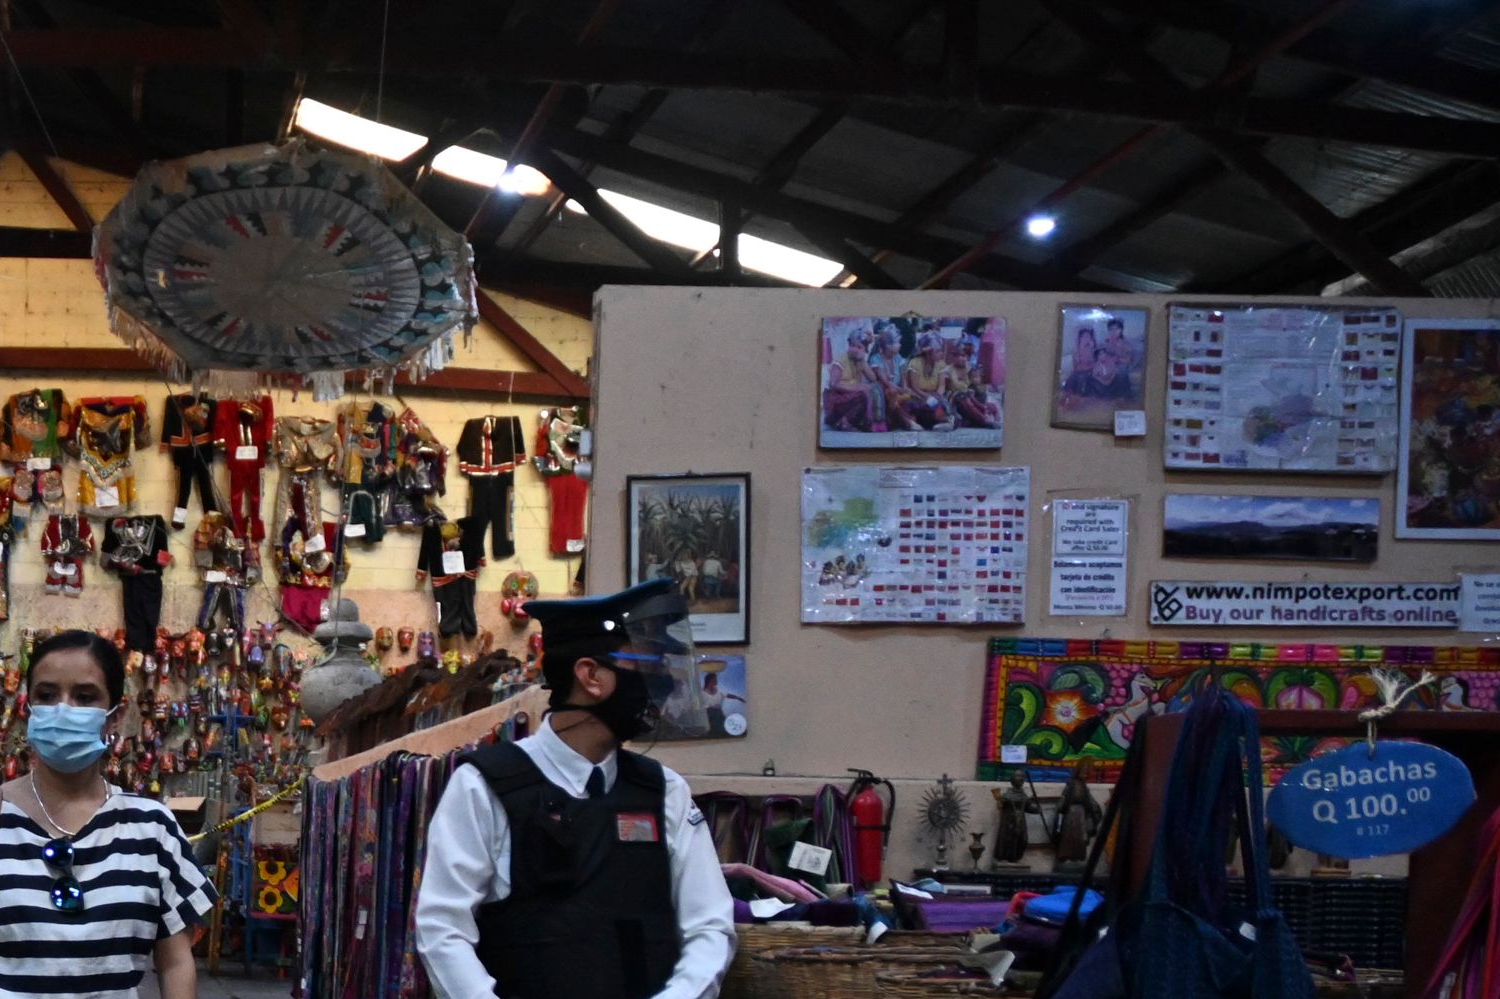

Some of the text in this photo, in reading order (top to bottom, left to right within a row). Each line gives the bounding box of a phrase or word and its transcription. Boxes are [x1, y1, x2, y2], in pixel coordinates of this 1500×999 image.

[1186, 584, 1460, 602] www.nimpotexport.com
[1186, 606, 1222, 621] Buy
[1229, 607, 1264, 620] our
[1271, 605, 1386, 621] handicrafts
[1393, 606, 1457, 622] online
[1302, 760, 1437, 791] Gabachas
[1312, 800, 1339, 824] Q
